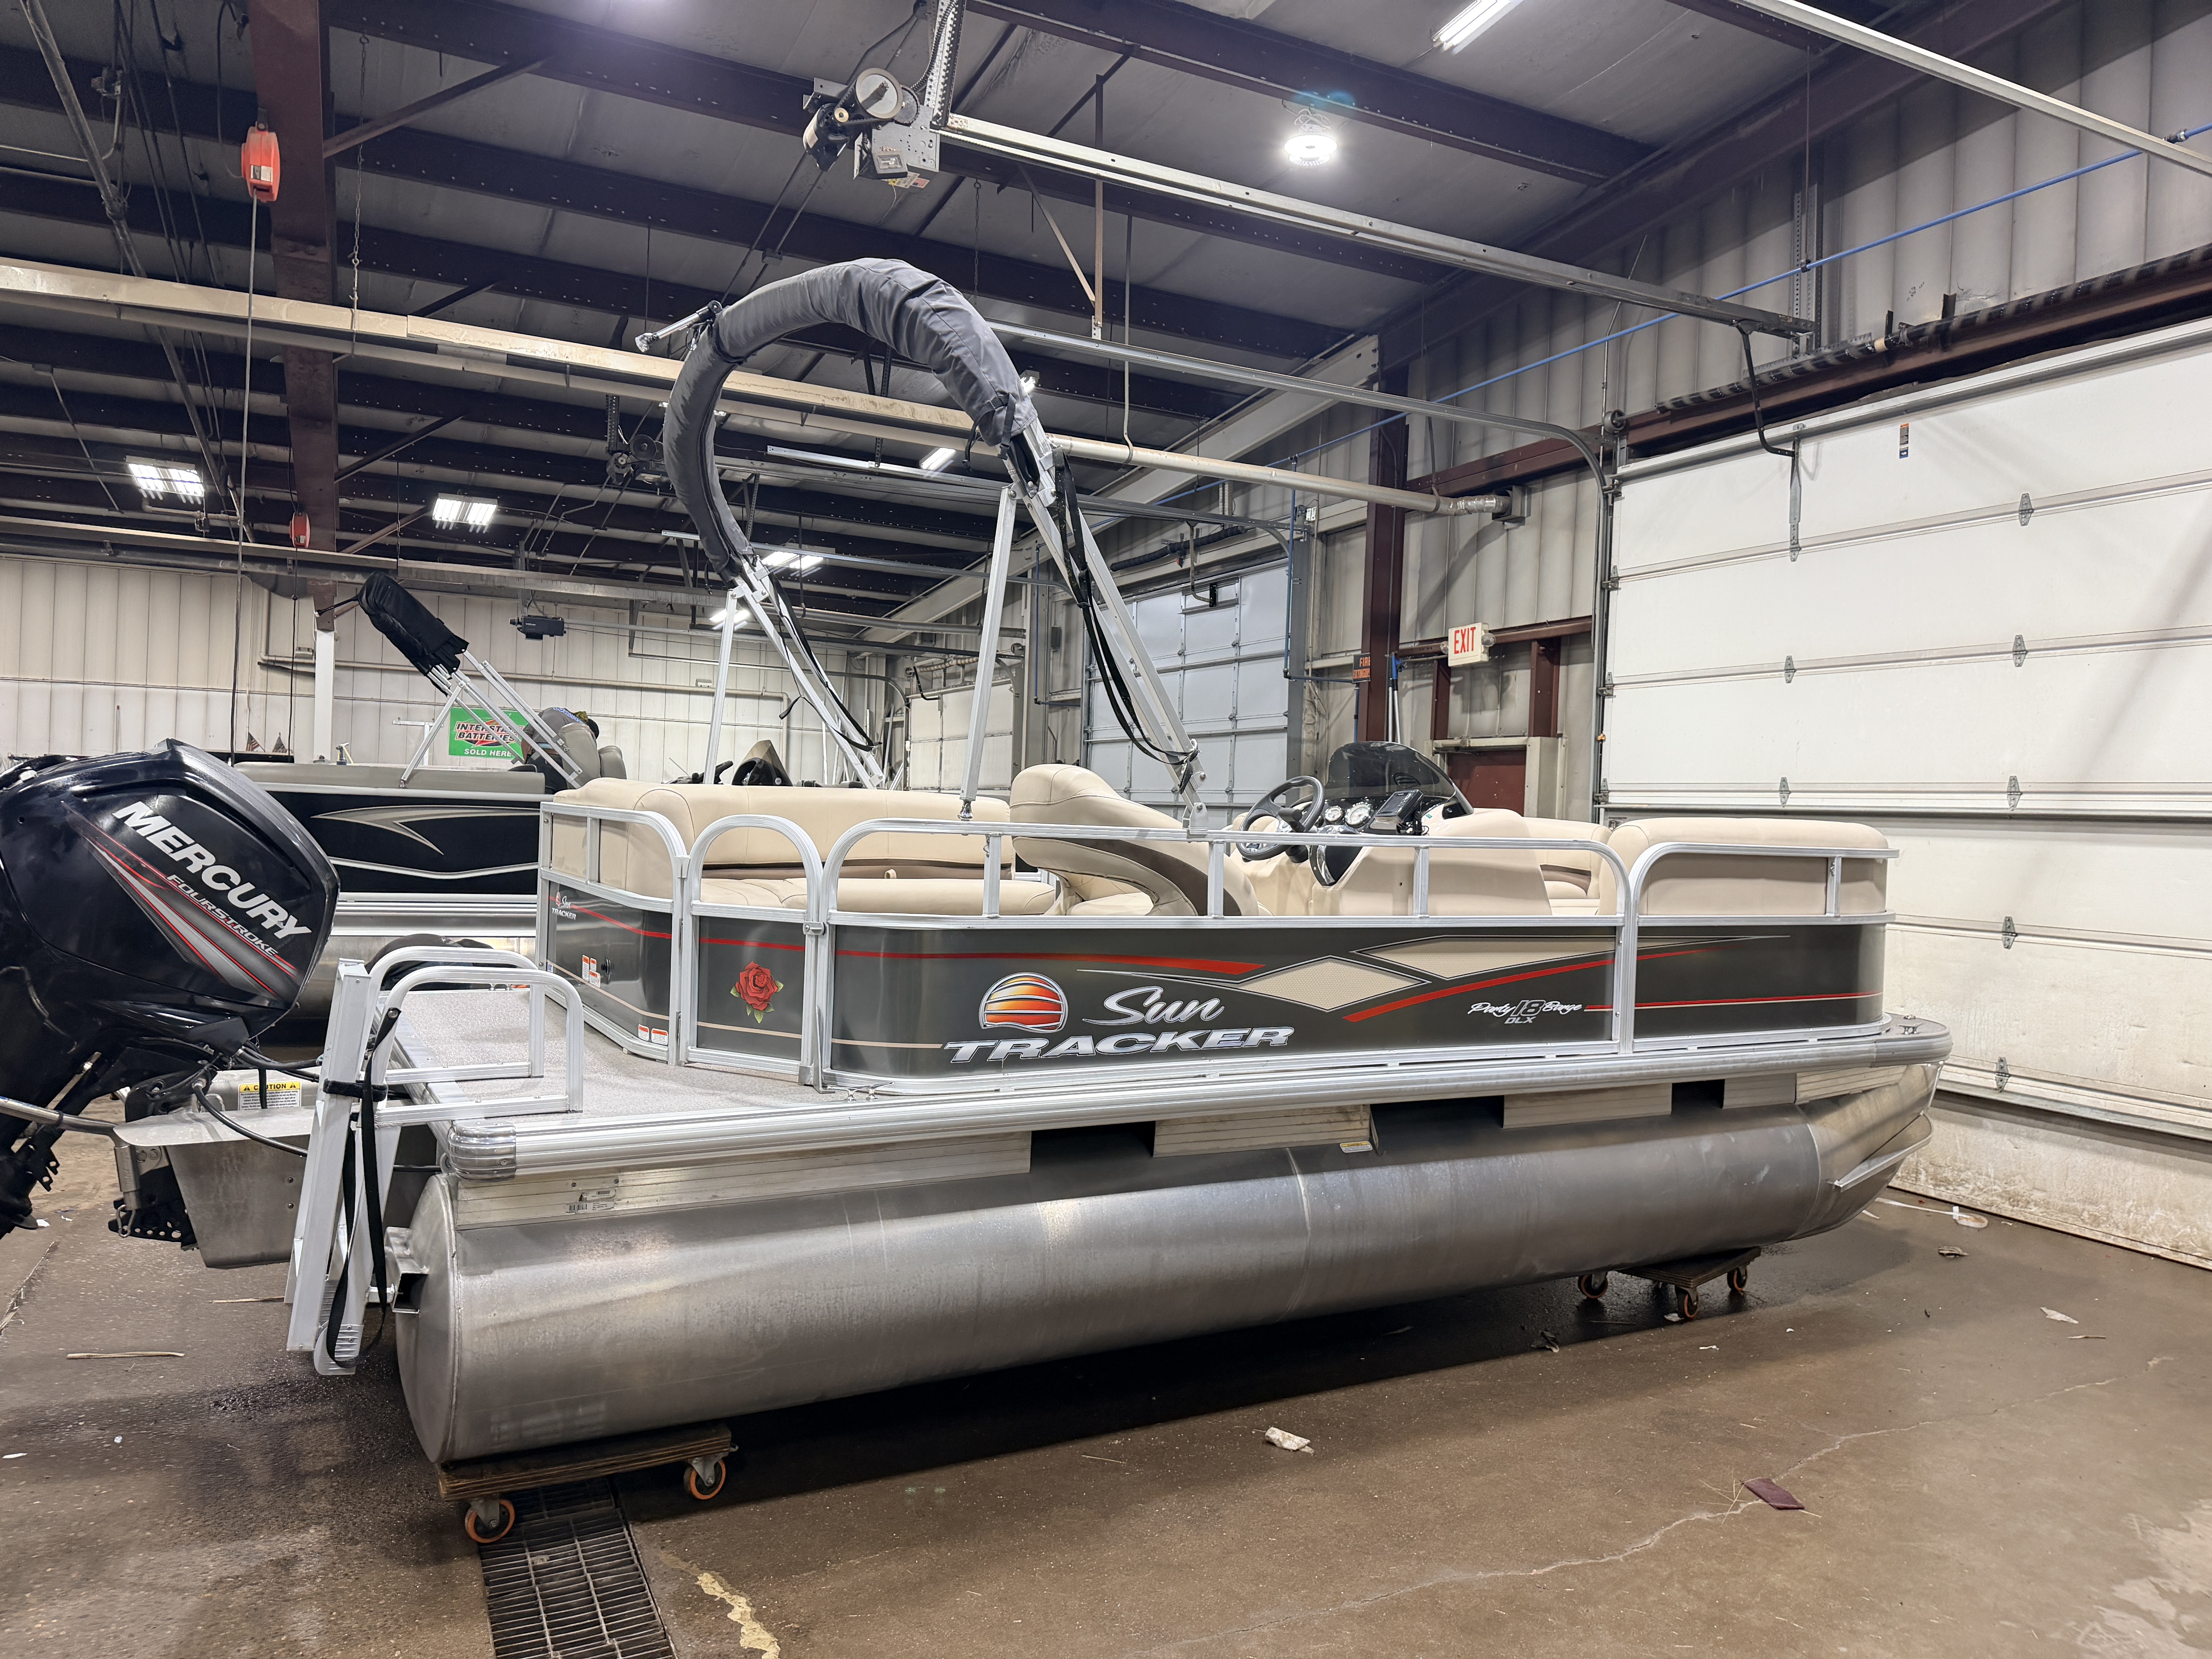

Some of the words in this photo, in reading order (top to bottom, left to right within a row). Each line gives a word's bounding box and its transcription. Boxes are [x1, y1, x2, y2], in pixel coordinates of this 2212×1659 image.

[1454, 627, 1476, 654] EXIT
[457, 722, 519, 735] INTERSTA
[112, 801, 312, 939] MERCURY
[167, 874, 278, 956] FOURSTROKE
[552, 908, 576, 920] TRACKER
[1082, 986, 1224, 1025] Sun
[1467, 1002, 1516, 1017] Party
[1510, 1000, 1546, 1017] 18
[1542, 1001, 1582, 1015] Barge
[943, 1027, 1294, 1063] TRACKER
